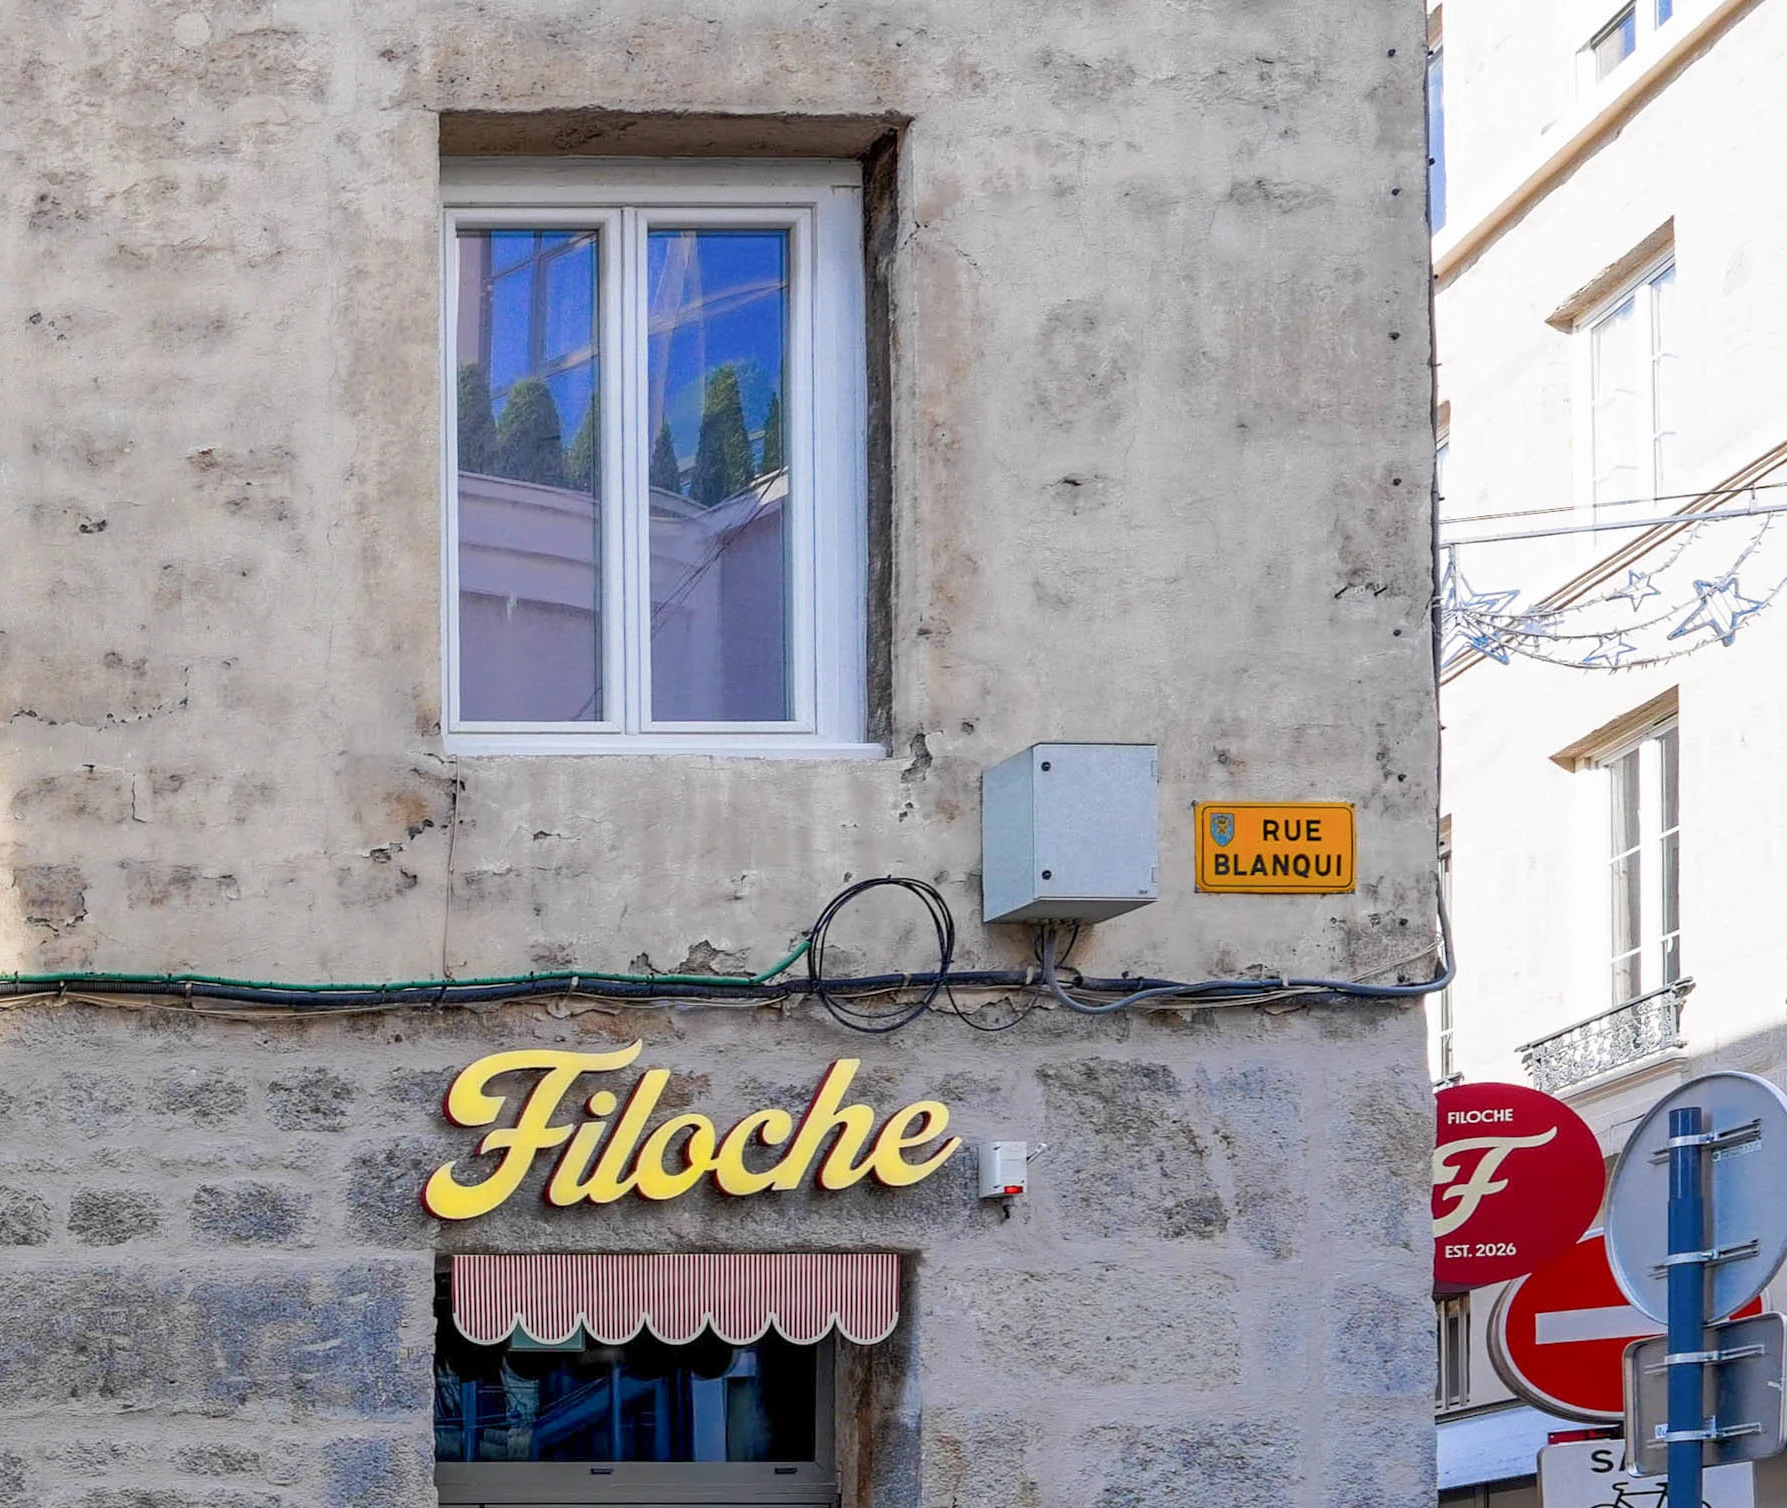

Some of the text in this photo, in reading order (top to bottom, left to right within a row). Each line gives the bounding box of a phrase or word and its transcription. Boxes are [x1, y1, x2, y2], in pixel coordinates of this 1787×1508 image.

[1262, 819, 1322, 842] RUE
[1214, 853, 1342, 878] BLANQUI
[1447, 1108, 1514, 1125] FILOCHE
[421, 1038, 963, 1221] Filoche
[1433, 1126, 1558, 1239] F
[1444, 1243, 1517, 1259] EST. 2026
